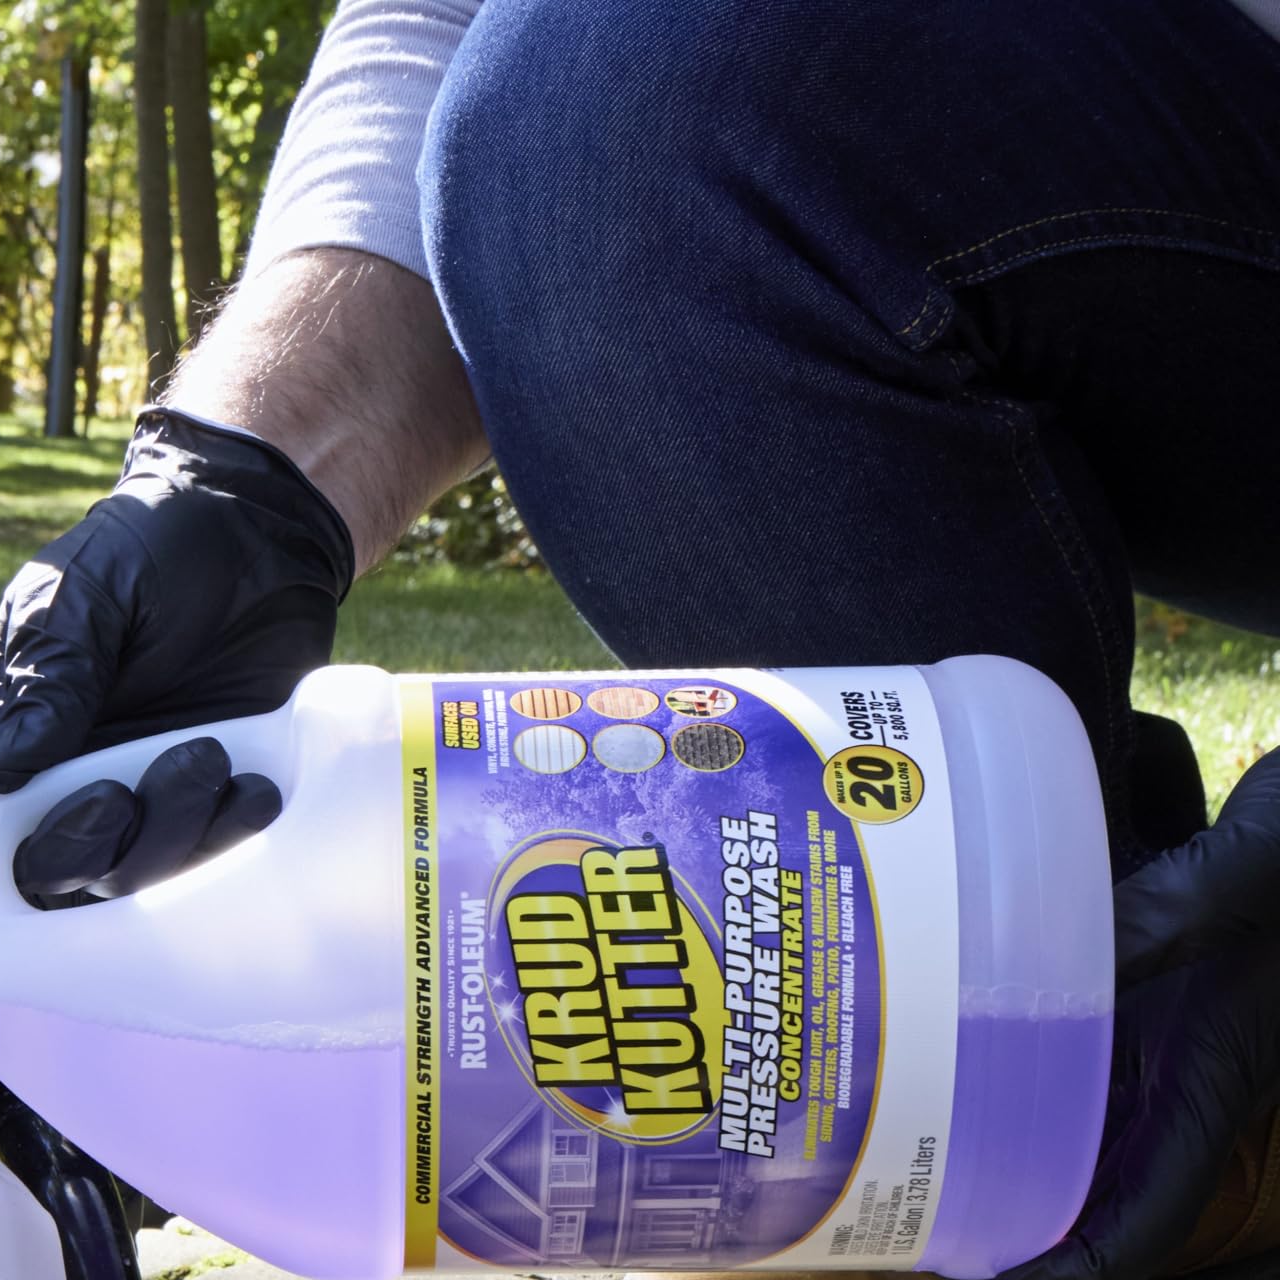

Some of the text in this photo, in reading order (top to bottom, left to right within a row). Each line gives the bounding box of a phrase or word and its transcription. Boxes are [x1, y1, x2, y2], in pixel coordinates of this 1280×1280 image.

[442, 701, 460, 748] SURFACES
[459, 701, 480, 749] USED ON
[840, 691, 874, 740] COVERS
[869, 701, 888, 725] UP TO
[889, 714, 909, 740] 5,800
[834, 781, 846, 804] MAKES
[835, 771, 842, 779] UP
[846, 756, 897, 811] 20
[897, 762, 912, 803] GALLONS
[806, 810, 820, 842] FROM
[823, 829, 836, 863] MORE
[808, 844, 822, 885] STAINS
[824, 865, 837, 875] &
[810, 887, 824, 936] MILDEW
[825, 876, 839, 942] FURNITURE
[812, 939, 824, 948] &
[413, 767, 431, 1204] COMMERCIAL STRENGTH ADVANCED FORMULA
[581, 845, 708, 1112] KUTTER
[719, 816, 753, 1152] MULTI-PURPOSE
[747, 811, 780, 1158] PRESSURE WASH
[779, 869, 803, 1101] CONCENTRATE
[812, 951, 824, 997] GREASE
[827, 946, 840, 984] PATIO,
[506, 895, 617, 1084] KRUD
[837, 865, 855, 1109] BIODEGRADABLE FORMULA BLEACH FREE
[812, 1002, 825, 1024] OIL,
[826, 988, 840, 1043] ROOFING,
[811, 1028, 824, 1057] DIRT,
[809, 1060, 821, 1097] TOUGH
[823, 1047, 839, 1100] GUTTERS,
[909, 1136, 936, 1175] Liters
[906, 1178, 930, 1201] 3.78
[897, 1208, 925, 1236] Gallon
